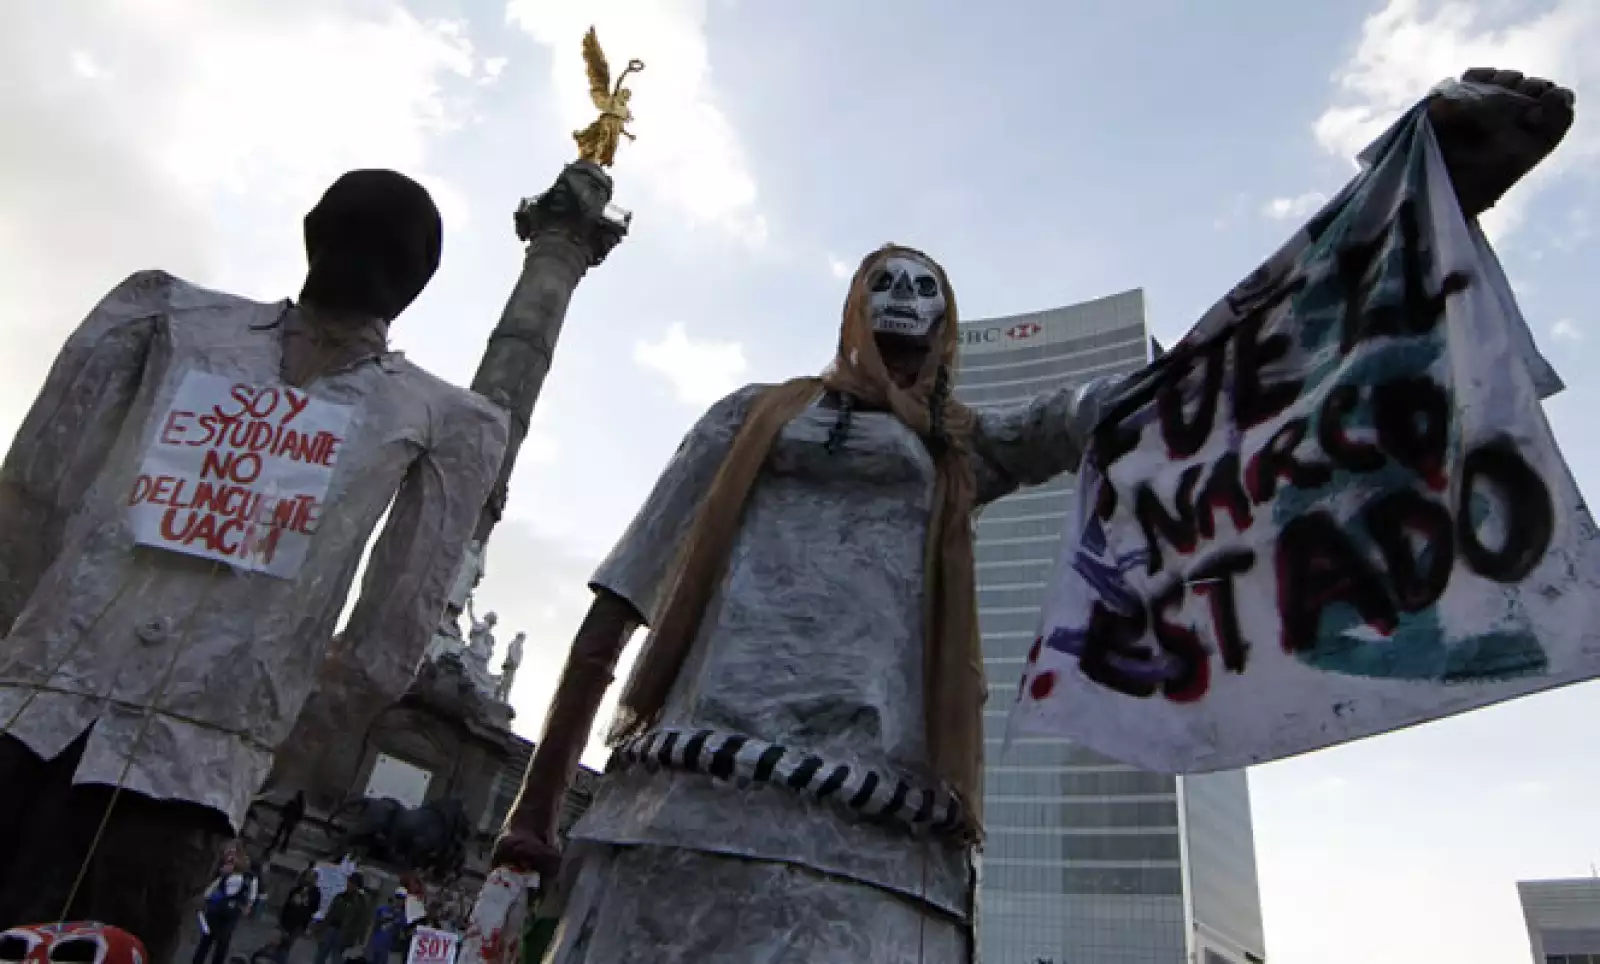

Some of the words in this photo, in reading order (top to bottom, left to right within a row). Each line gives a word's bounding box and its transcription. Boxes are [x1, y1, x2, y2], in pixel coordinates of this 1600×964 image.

[957, 327, 1001, 344] SBC
[212, 383, 309, 424] SOY
[160, 411, 342, 467] ESTUDIANTE
[200, 450, 263, 483] NO
[1133, 373, 1453, 577] NARCO
[128, 474, 321, 535] DELINCUENTE
[1080, 432, 1554, 702] ESTADO
[416, 935, 451, 958] SOY
